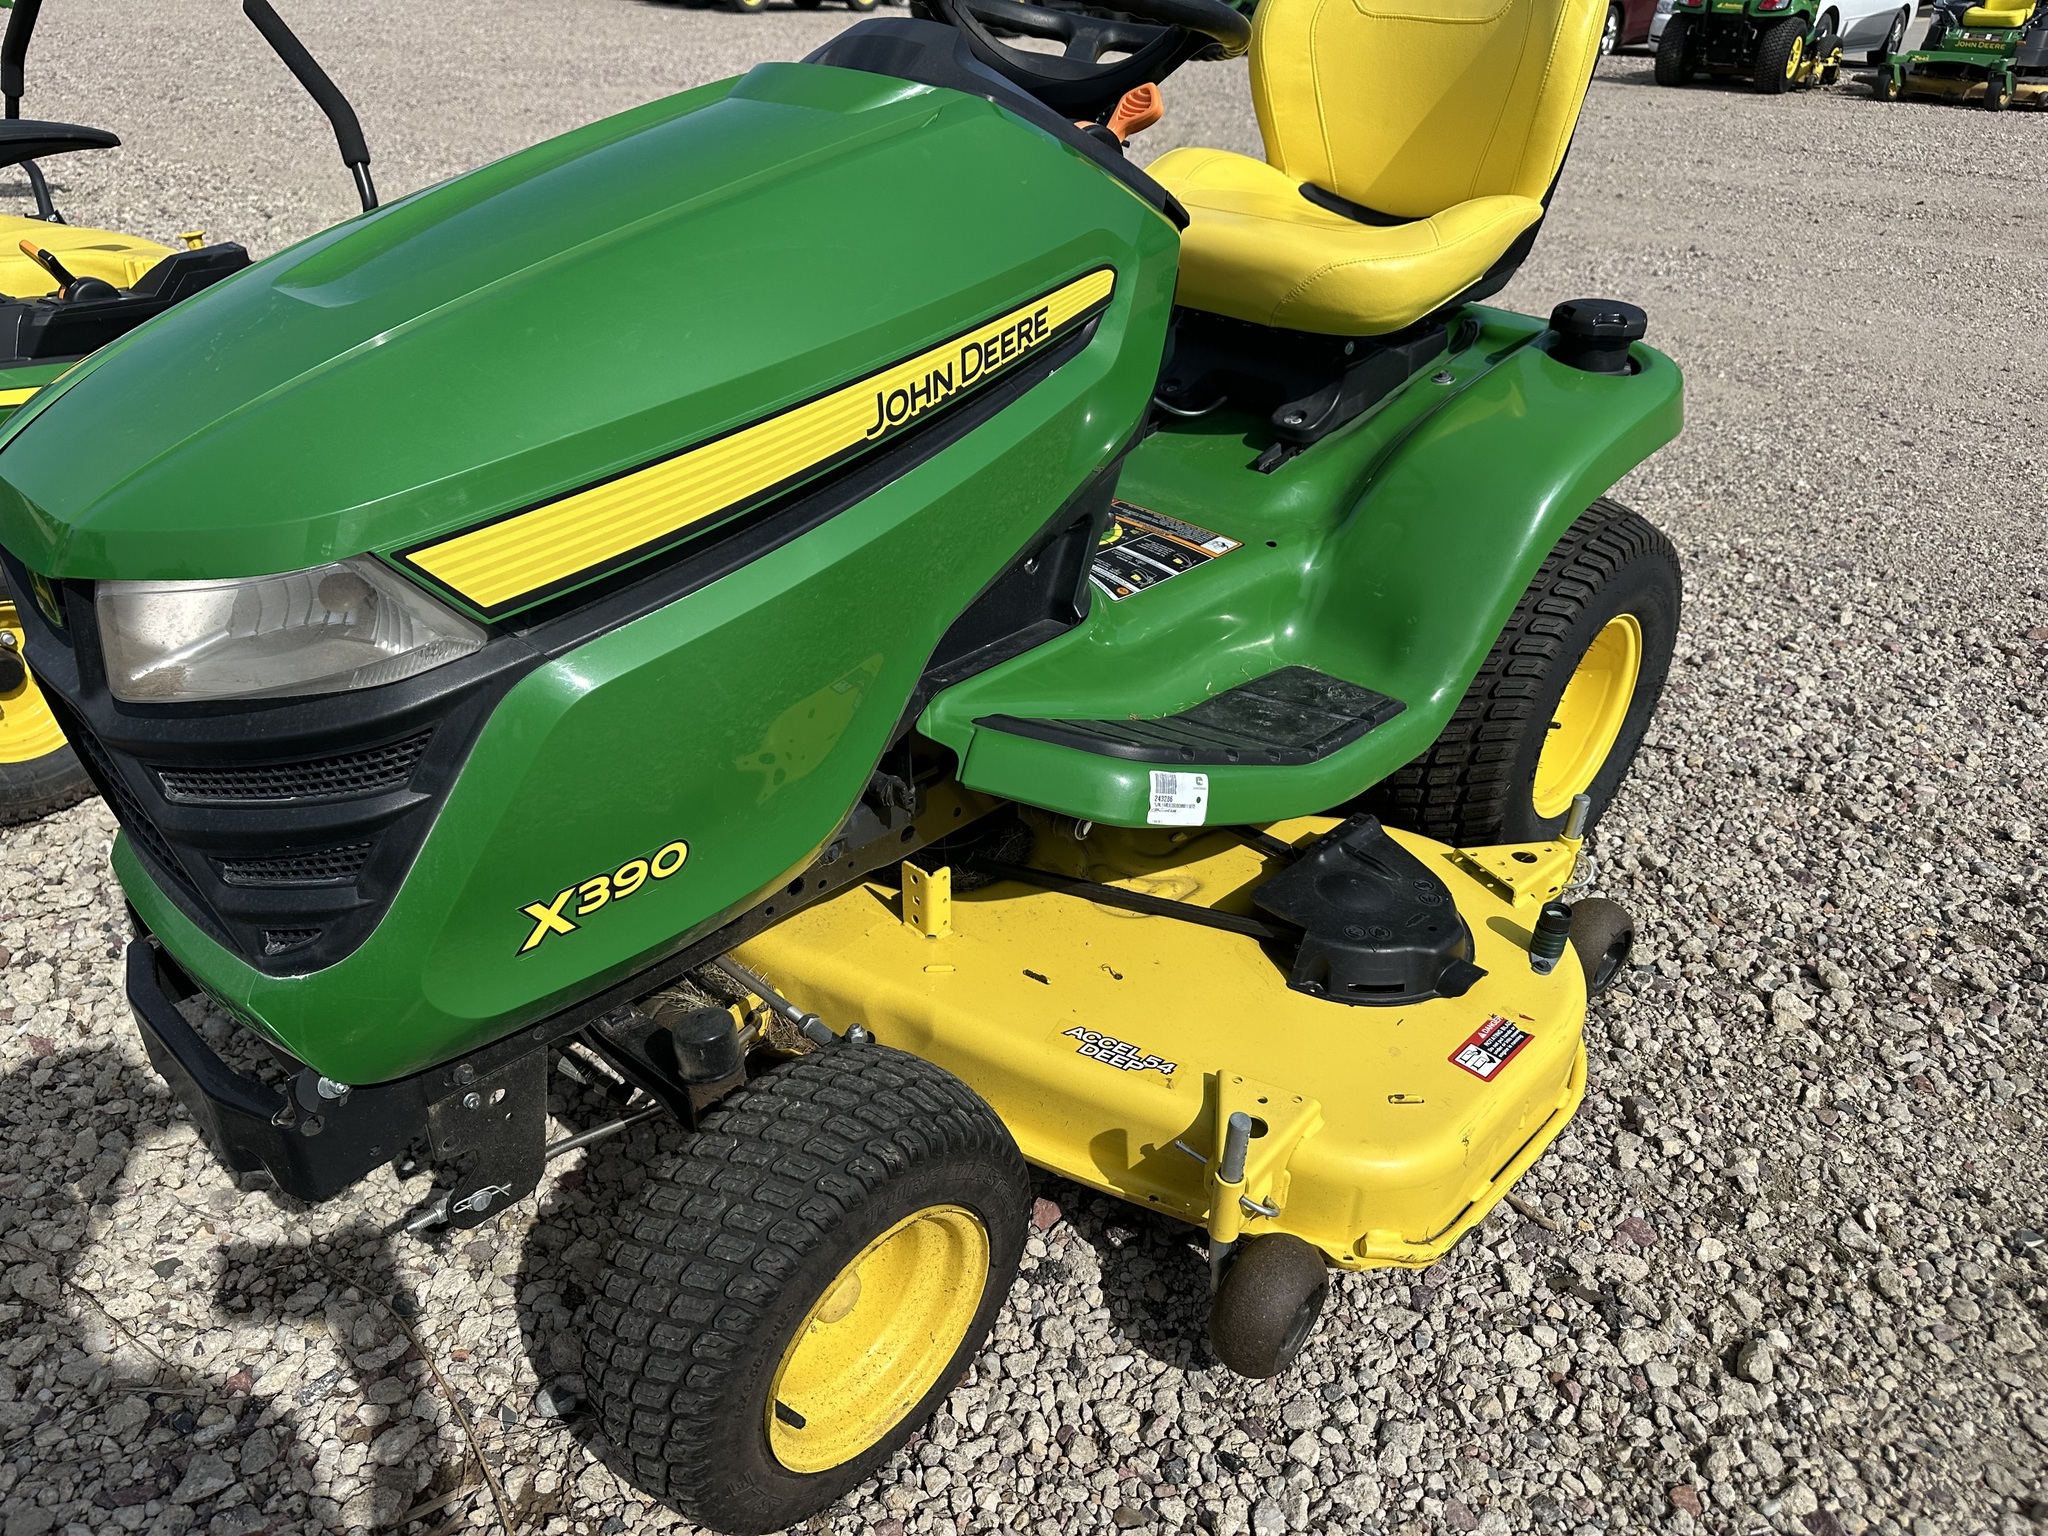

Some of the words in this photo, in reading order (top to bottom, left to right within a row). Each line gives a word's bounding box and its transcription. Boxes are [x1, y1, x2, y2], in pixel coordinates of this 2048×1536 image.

[1954, 40, 1977, 48] JOHN
[1978, 41, 2007, 50] DEERE
[866, 361, 954, 438] JOHN
[960, 304, 1050, 386] DEERE
[515, 839, 690, 957] X390
[1061, 1026, 1142, 1062] ACCEL
[1142, 1054, 1178, 1075] 54
[1076, 1043, 1146, 1072] DEEP
[1483, 1030, 1503, 1046] ROTATING
[865, 1165, 944, 1225] TURF
